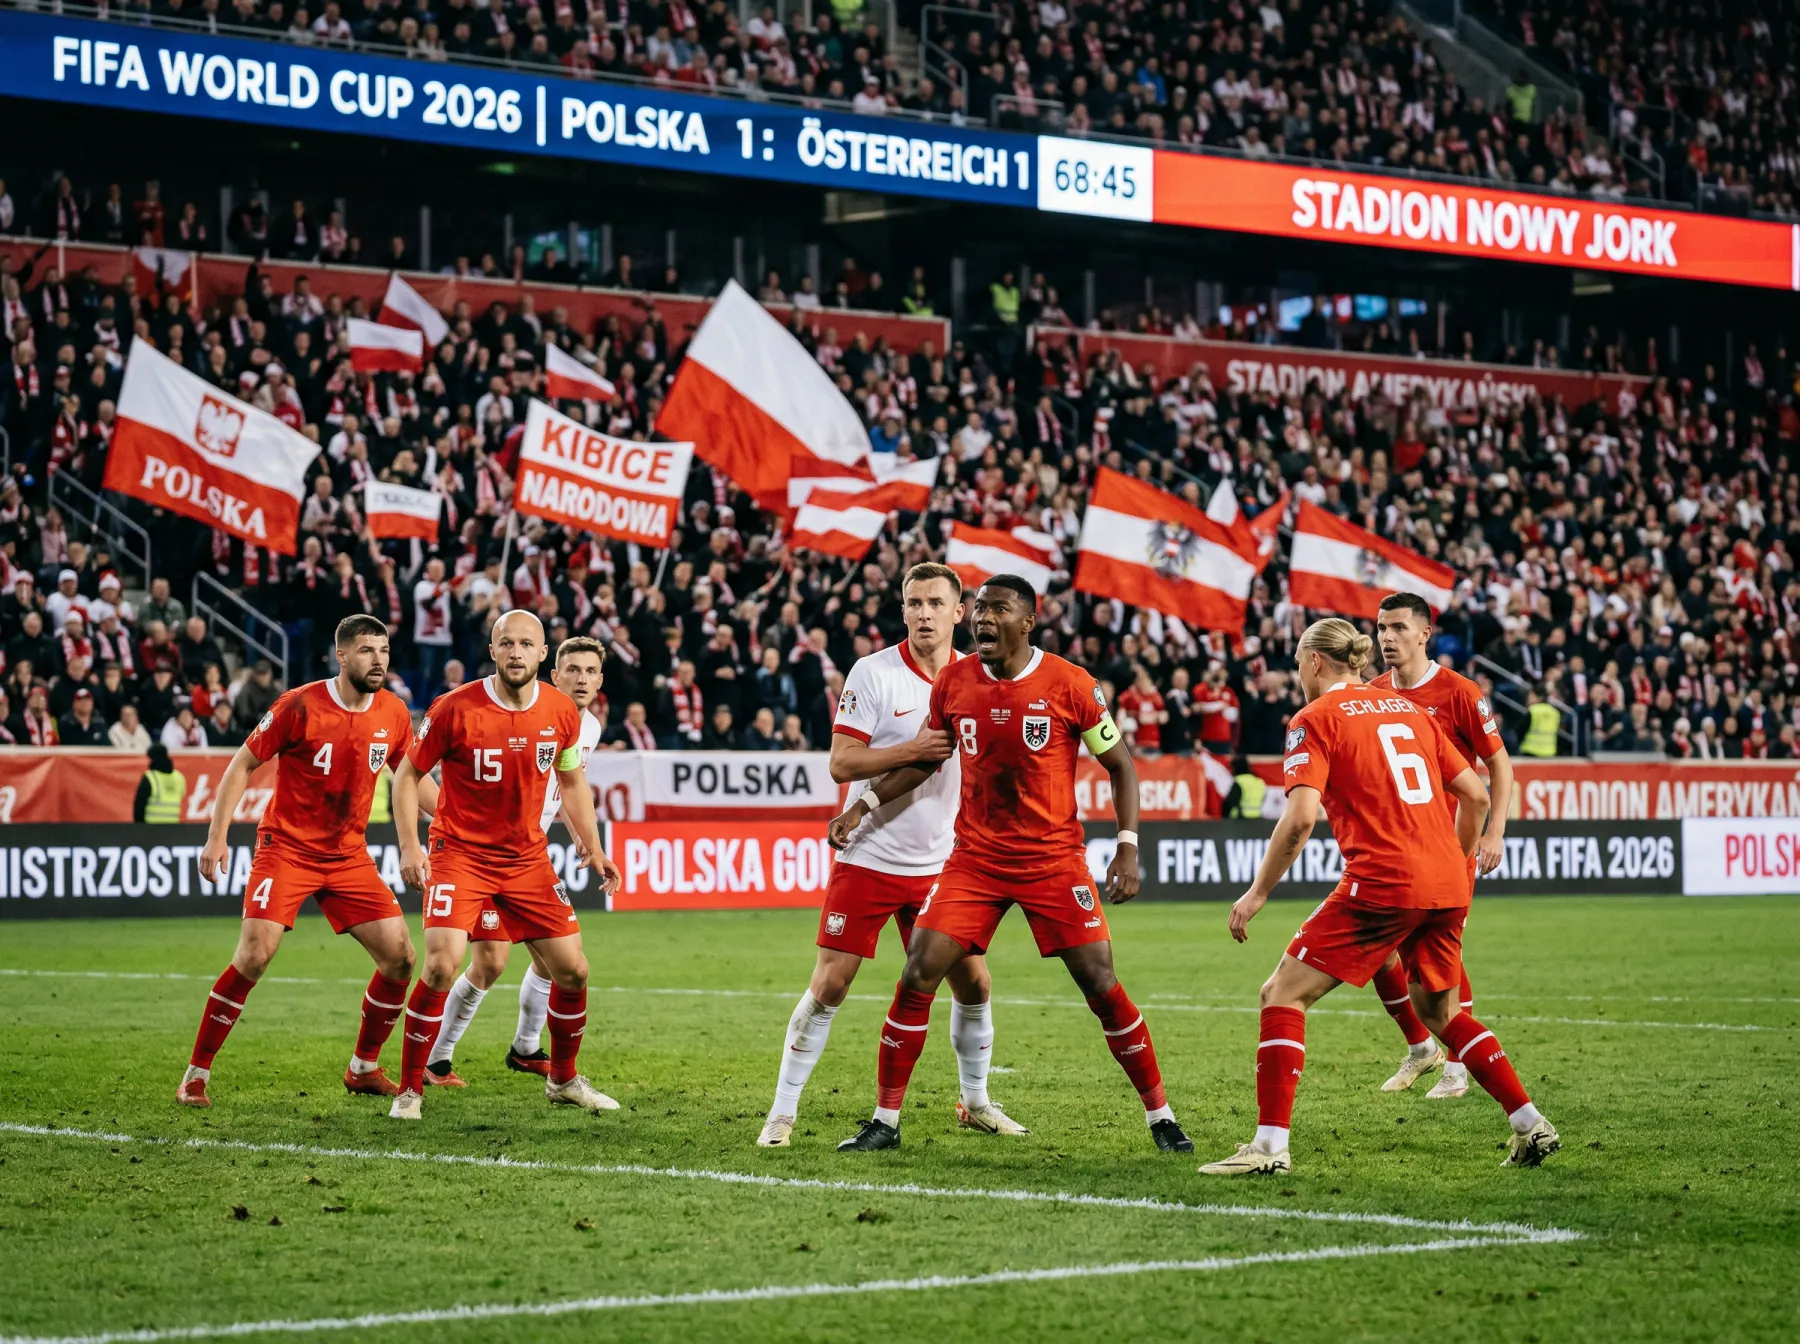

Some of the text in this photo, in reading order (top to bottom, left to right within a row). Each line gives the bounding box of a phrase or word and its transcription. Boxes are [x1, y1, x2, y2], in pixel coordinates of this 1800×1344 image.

[53, 37, 149, 91] FIFA
[158, 49, 320, 109] WORLD
[329, 71, 413, 119] CUP
[422, 81, 522, 133] 2026
[561, 101, 711, 155] POLSKA
[797, 117, 1008, 187] ÖSTERREICH
[1013, 151, 1030, 190] 1
[1054, 159, 1137, 199] 68:45
[1291, 179, 1677, 266] STADION NOWY JORK
[541, 419, 674, 484] KIBICE
[140, 454, 268, 541] POLSKA
[520, 469, 669, 540] NARODOWA
[959, 718, 979, 756] 8
[1099, 724, 1115, 743] C
[312, 742, 334, 776] 4
[473, 748, 503, 783] 15
[672, 762, 812, 796] POLSKA
[1376, 722, 1434, 806] 6
[1525, 780, 1649, 819] STADION
[0, 845, 254, 899] ISTRZOSTWA
[624, 837, 766, 895] POLSKA
[1157, 838, 1222, 884] FIFA
[1546, 837, 1603, 879] FIFA
[1607, 835, 1675, 880] 2026
[252, 877, 274, 910] 4
[426, 883, 456, 918] 15
